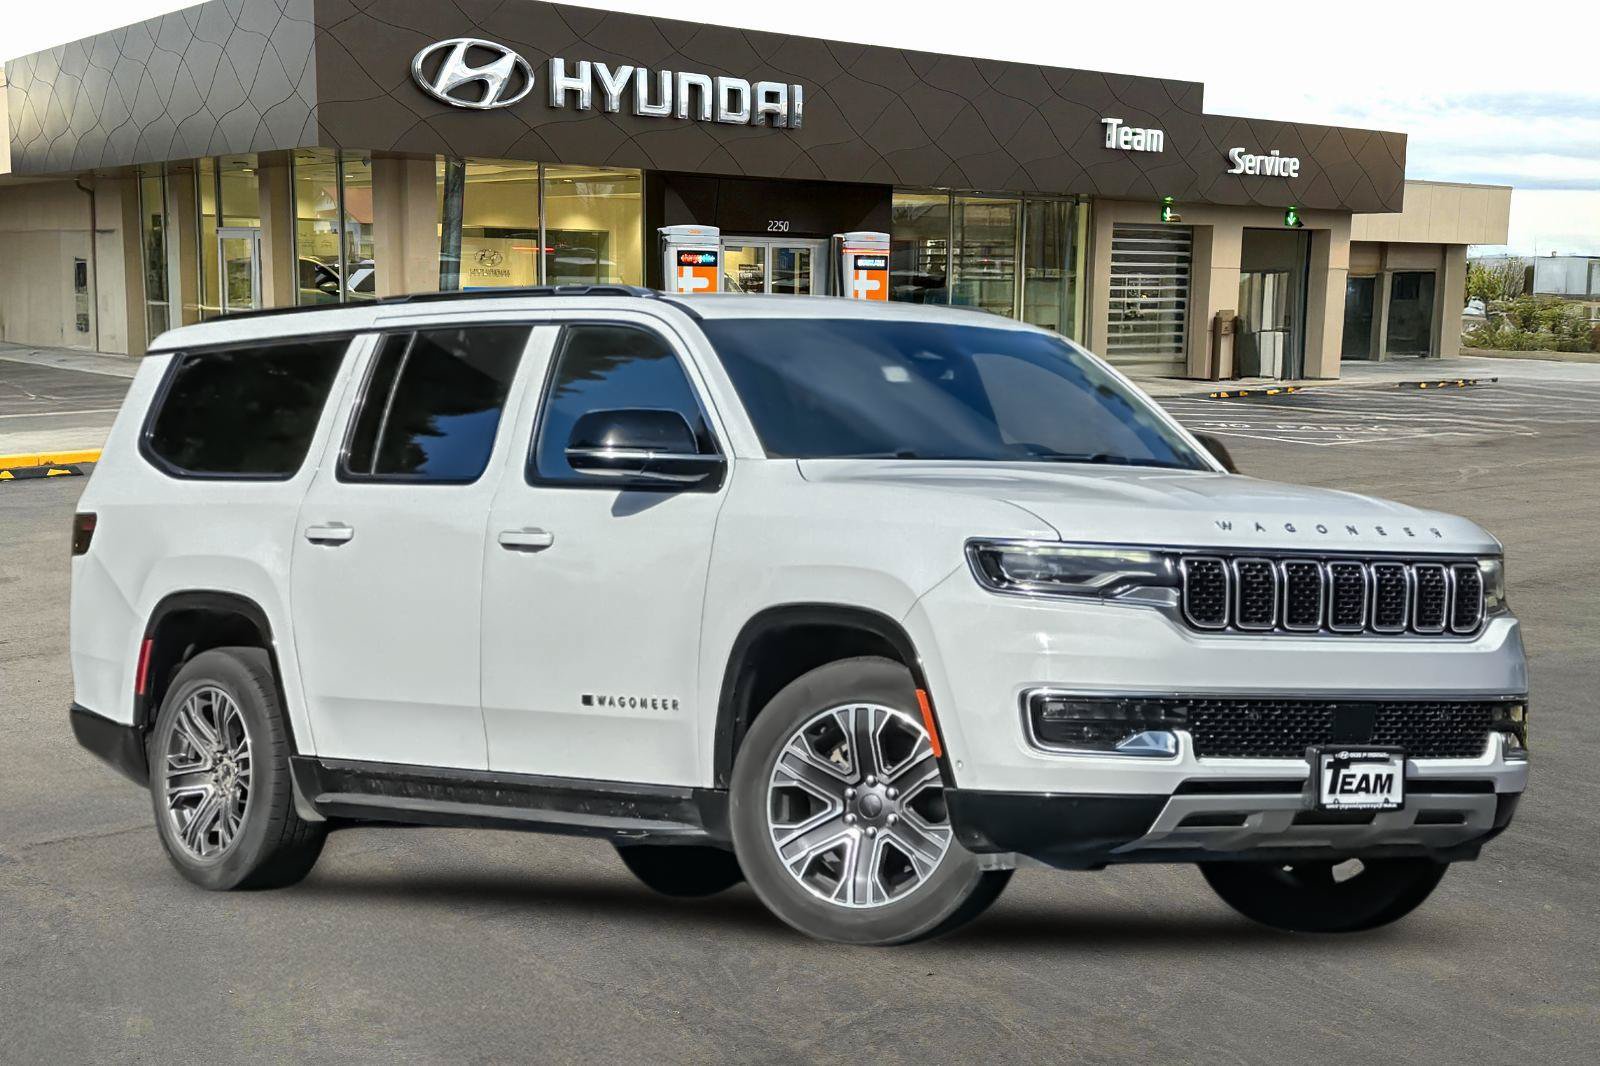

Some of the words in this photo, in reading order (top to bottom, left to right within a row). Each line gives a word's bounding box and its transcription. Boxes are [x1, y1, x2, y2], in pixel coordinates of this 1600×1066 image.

[549, 58, 803, 129] HYUNDAI
[1101, 117, 1164, 153] Team
[1227, 146, 1300, 178] Service
[767, 220, 790, 232] 2250
[1215, 520, 1443, 538] WAGONEER
[596, 695, 680, 711] WAGONEER
[1325, 760, 1394, 795] TEAM
